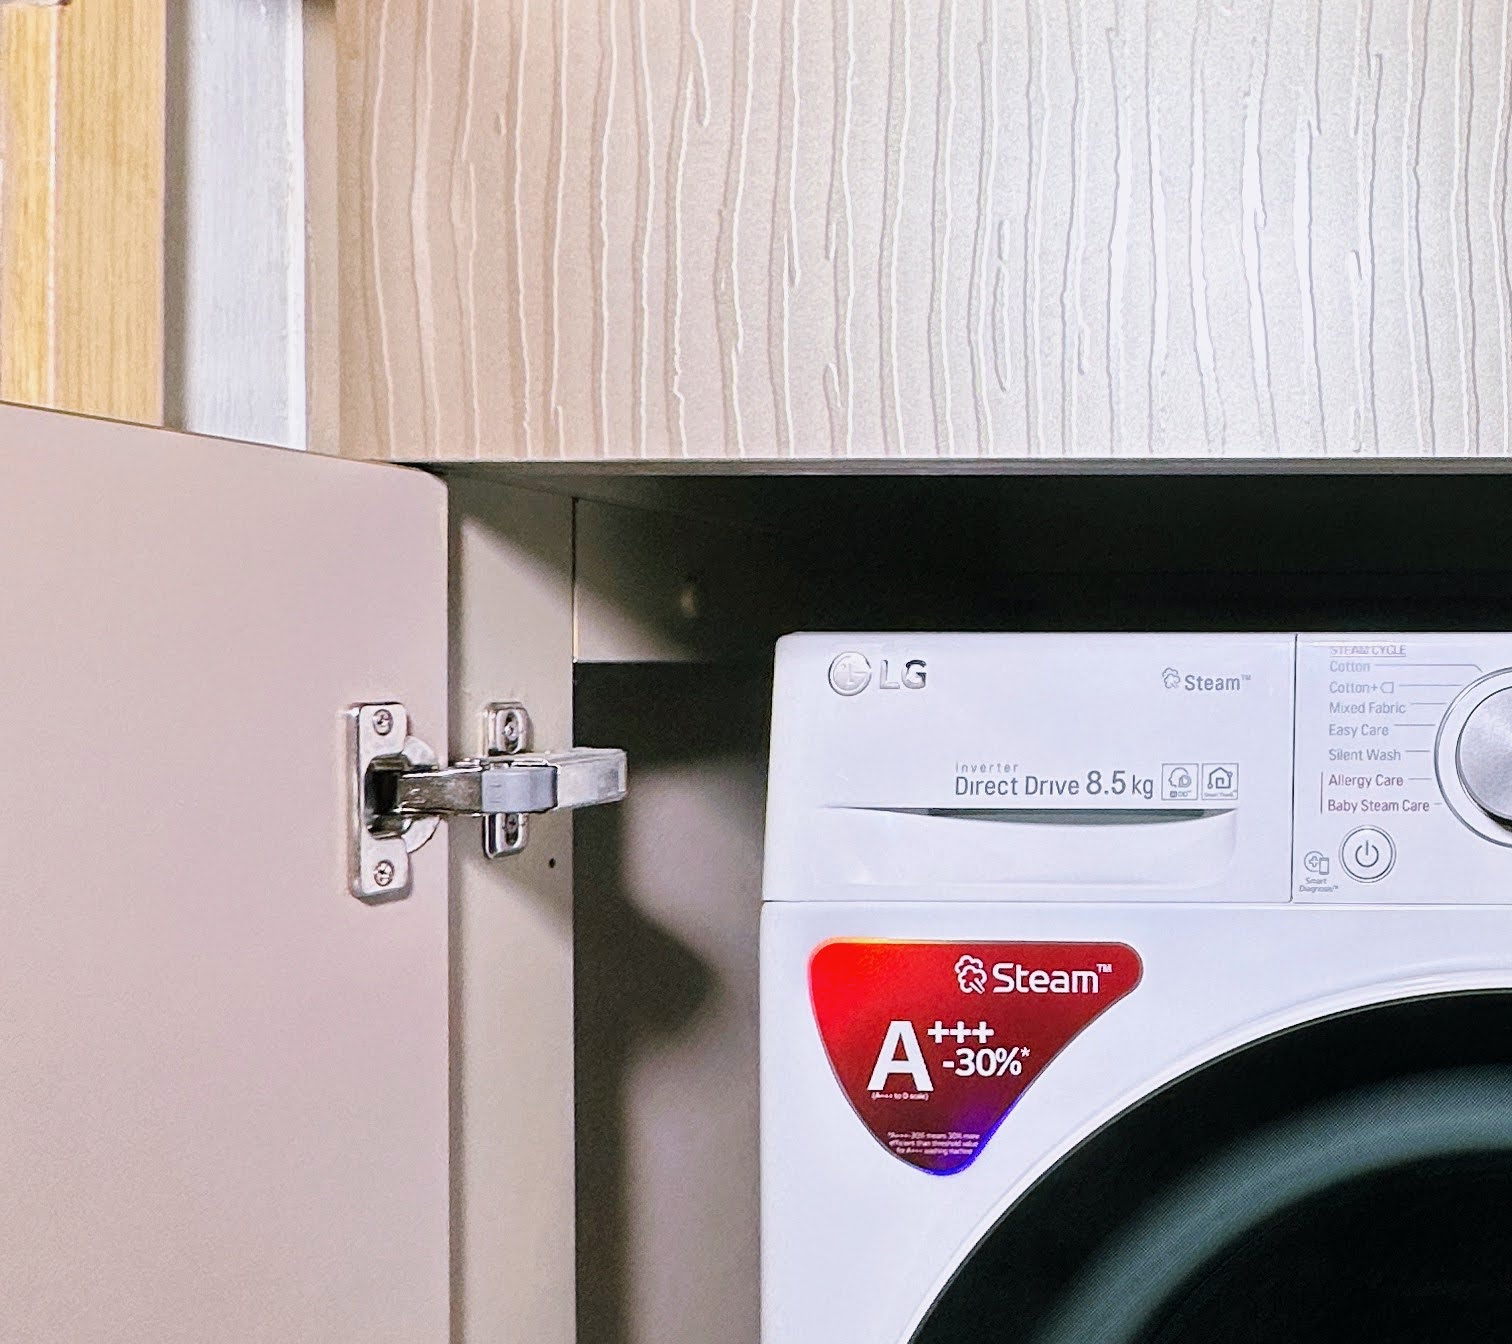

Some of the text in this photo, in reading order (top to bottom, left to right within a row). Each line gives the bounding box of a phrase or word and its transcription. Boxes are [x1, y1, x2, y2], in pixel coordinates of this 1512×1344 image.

[1371, 644, 1407, 655] CYCLE
[1329, 660, 1371, 673] Cotton
[879, 659, 927, 690] LG
[1329, 701, 1407, 714] Mixed Fabric
[1328, 723, 1389, 739] Easy Care
[1328, 748, 1402, 761] Silent Wash
[955, 769, 1154, 800] Direct Drive 8.5 kg
[1328, 773, 1404, 789] Allergy Care
[1327, 799, 1430, 814] Baby Steam Care
